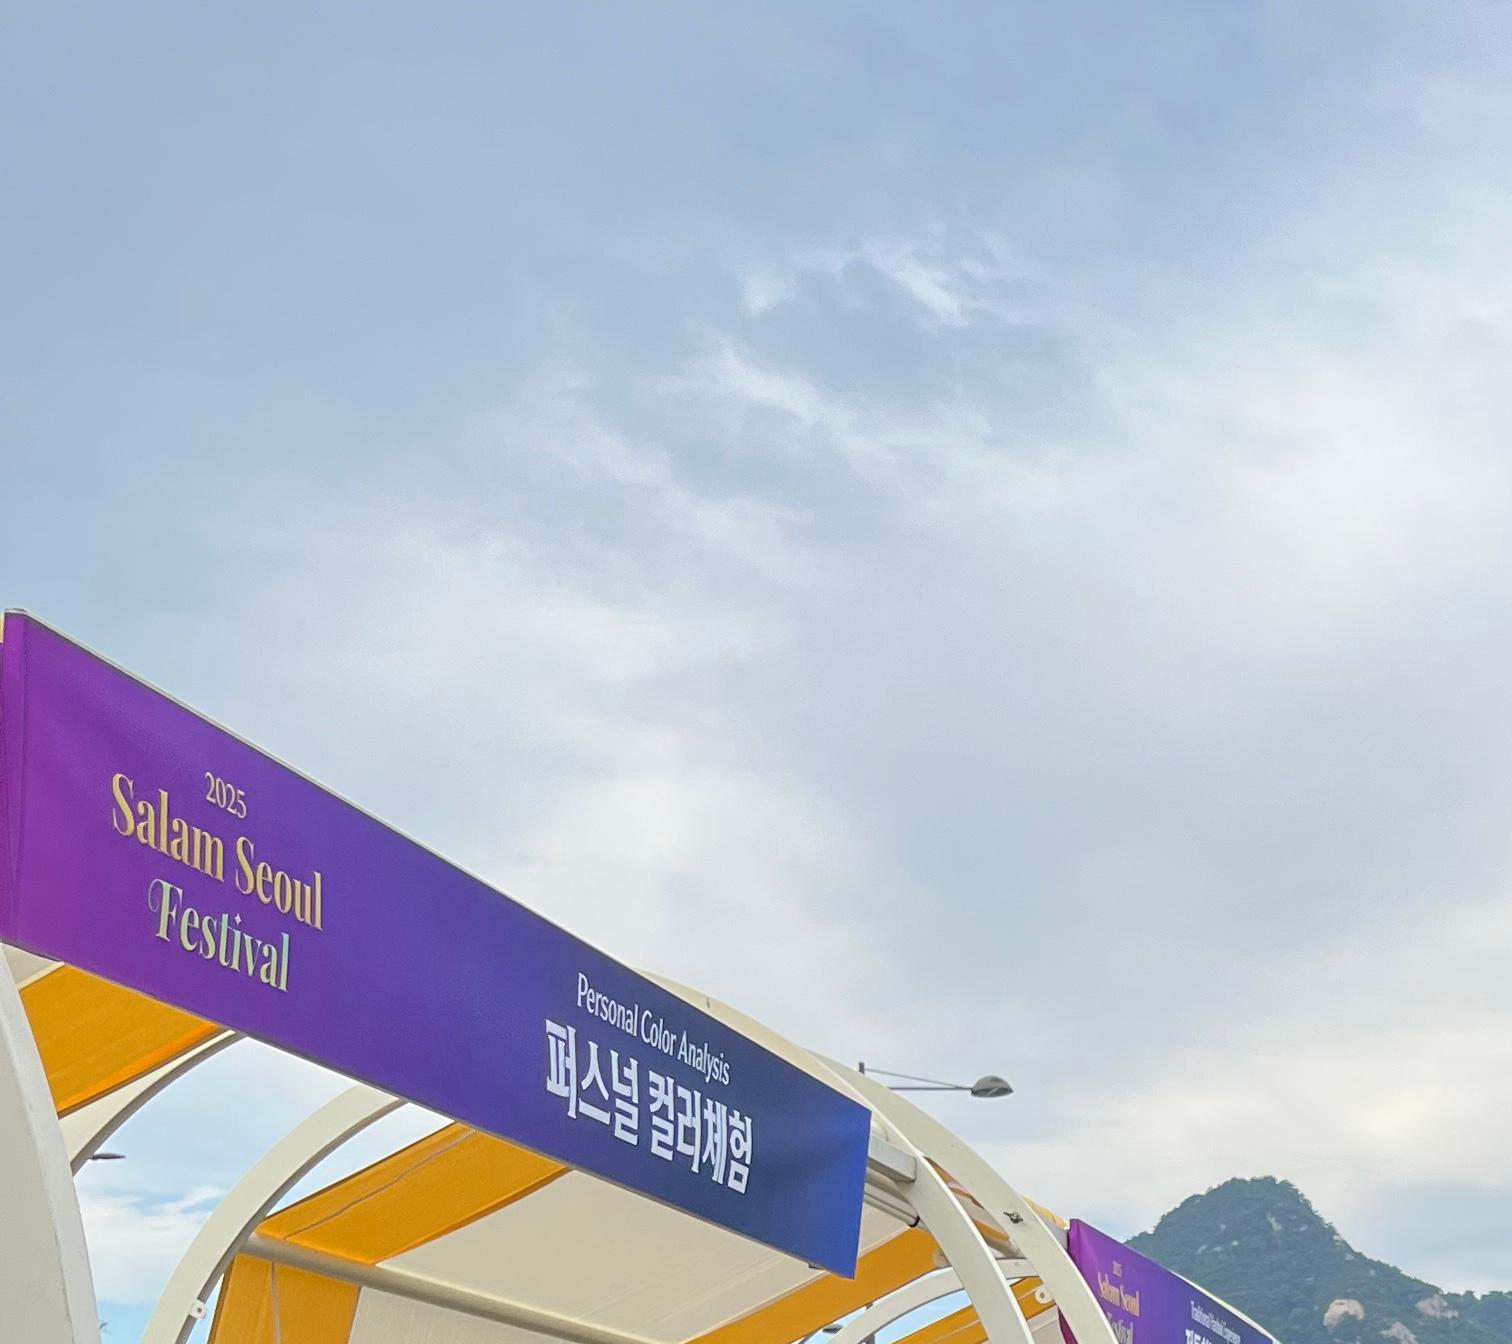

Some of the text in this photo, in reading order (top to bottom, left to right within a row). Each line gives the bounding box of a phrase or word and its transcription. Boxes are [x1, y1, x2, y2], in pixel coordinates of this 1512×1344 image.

[111, 773, 324, 932] Salam Seoul
[205, 771, 247, 819] 2025
[148, 878, 290, 993] Festival
[577, 972, 730, 1086] Personal Color Analysis
[545, 1018, 753, 1195] 퍼스널 컬러체험
